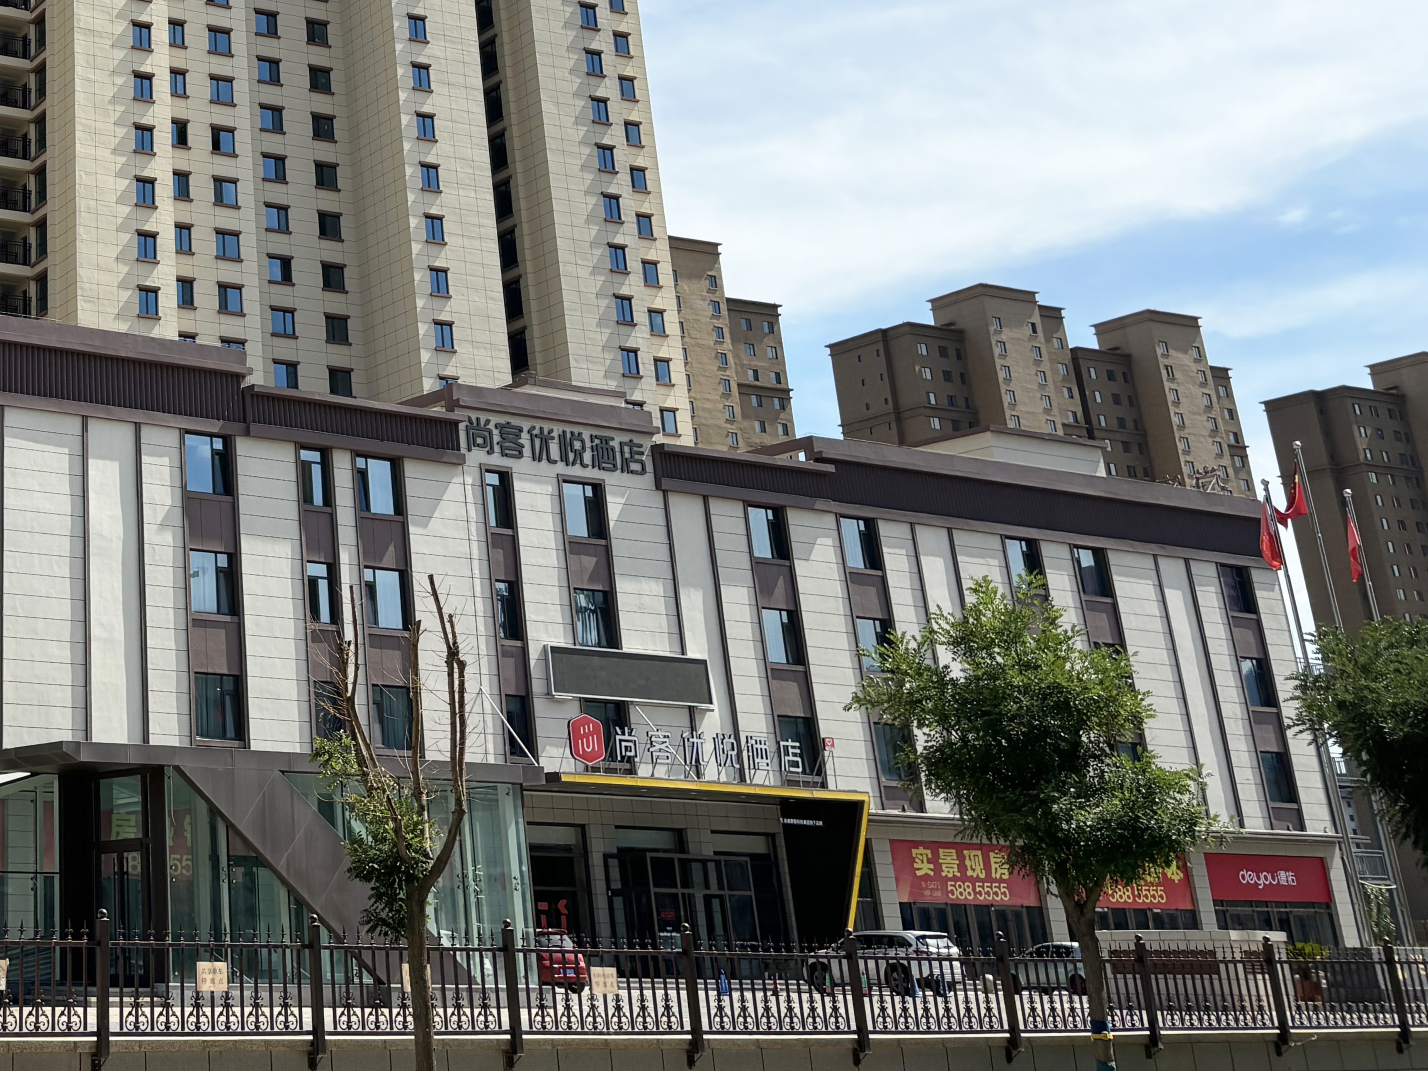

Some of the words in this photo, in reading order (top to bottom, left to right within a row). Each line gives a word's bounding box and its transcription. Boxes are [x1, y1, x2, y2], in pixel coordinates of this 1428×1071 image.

[465, 415, 647, 475] 尚客优悦酒店
[614, 725, 803, 774] 尚客优悦酒店
[911, 846, 1010, 879] 实景现房
[947, 881, 974, 900] 588
[975, 882, 1010, 901] 5555
[1239, 869, 1278, 889] deyou
[1108, 886, 1133, 903] 588
